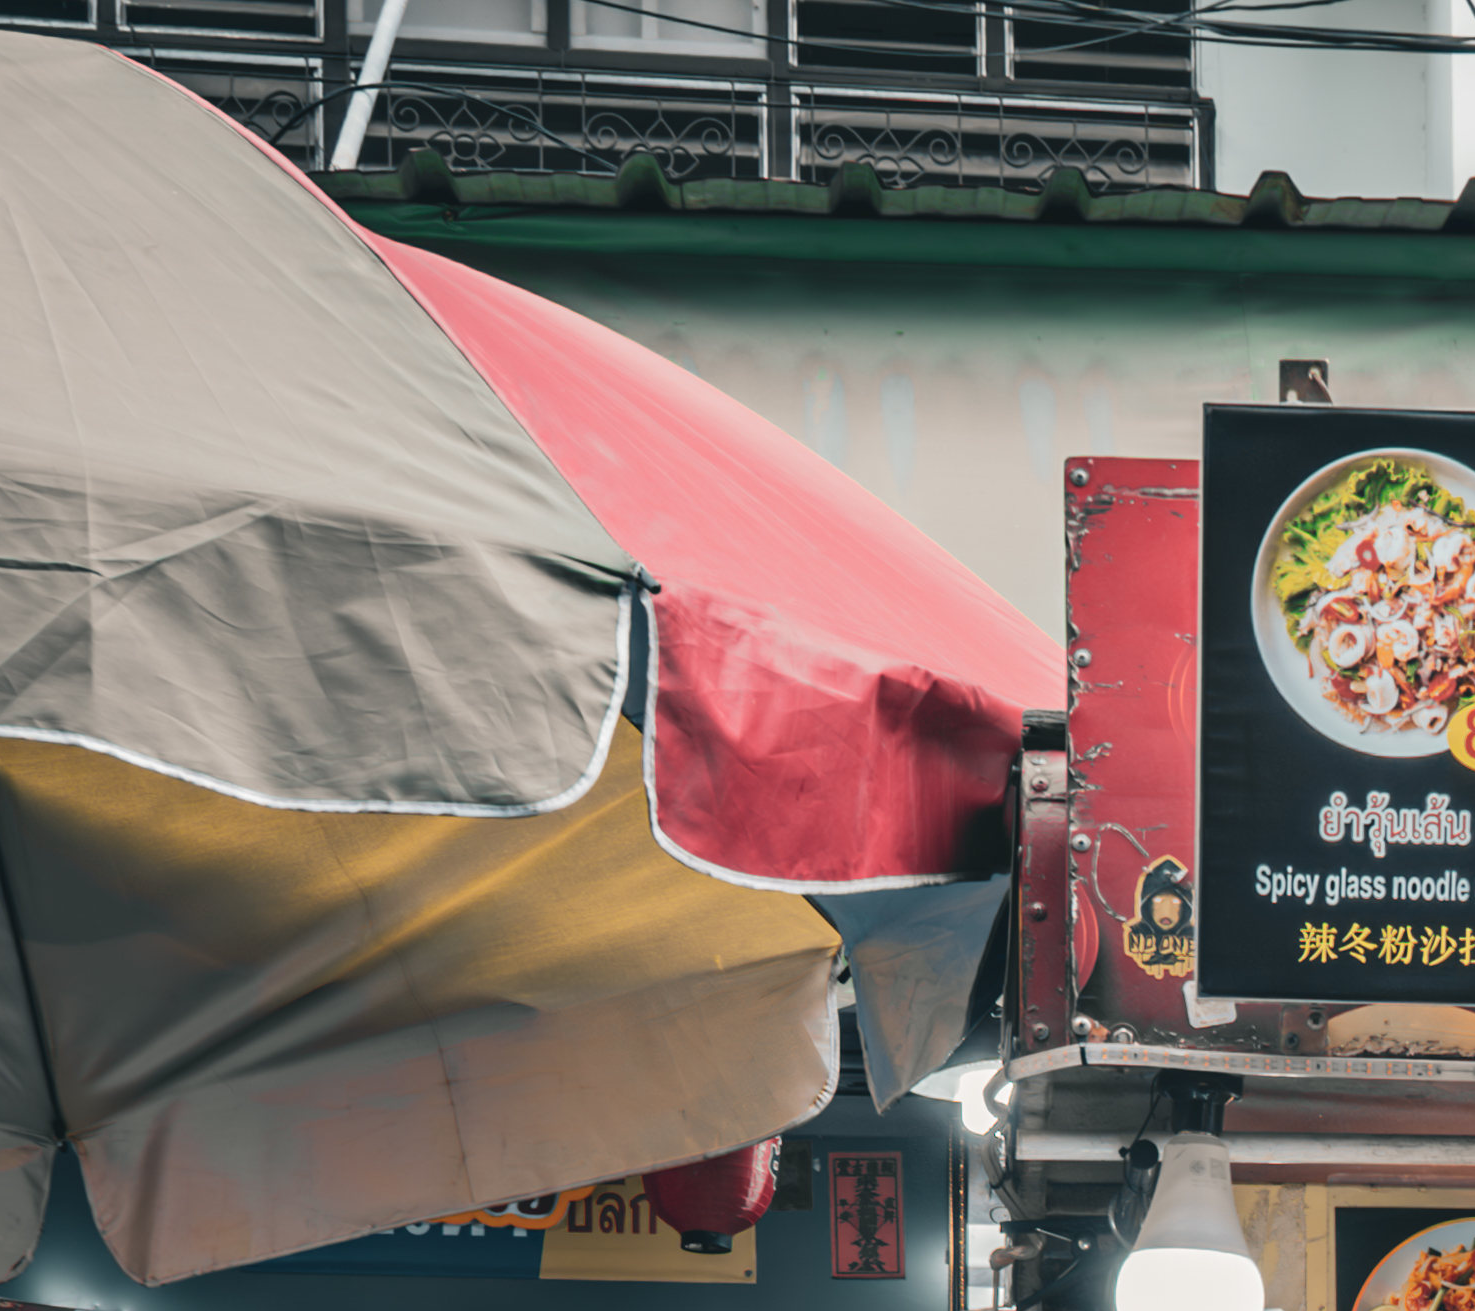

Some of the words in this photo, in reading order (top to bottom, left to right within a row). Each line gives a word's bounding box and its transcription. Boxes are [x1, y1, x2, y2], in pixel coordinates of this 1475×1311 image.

[1319, 790, 1471, 858] ยำวุ้นเส้น
[1256, 864, 1319, 905] Spicy
[1325, 867, 1386, 905] glass
[1392, 870, 1470, 902] noodle
